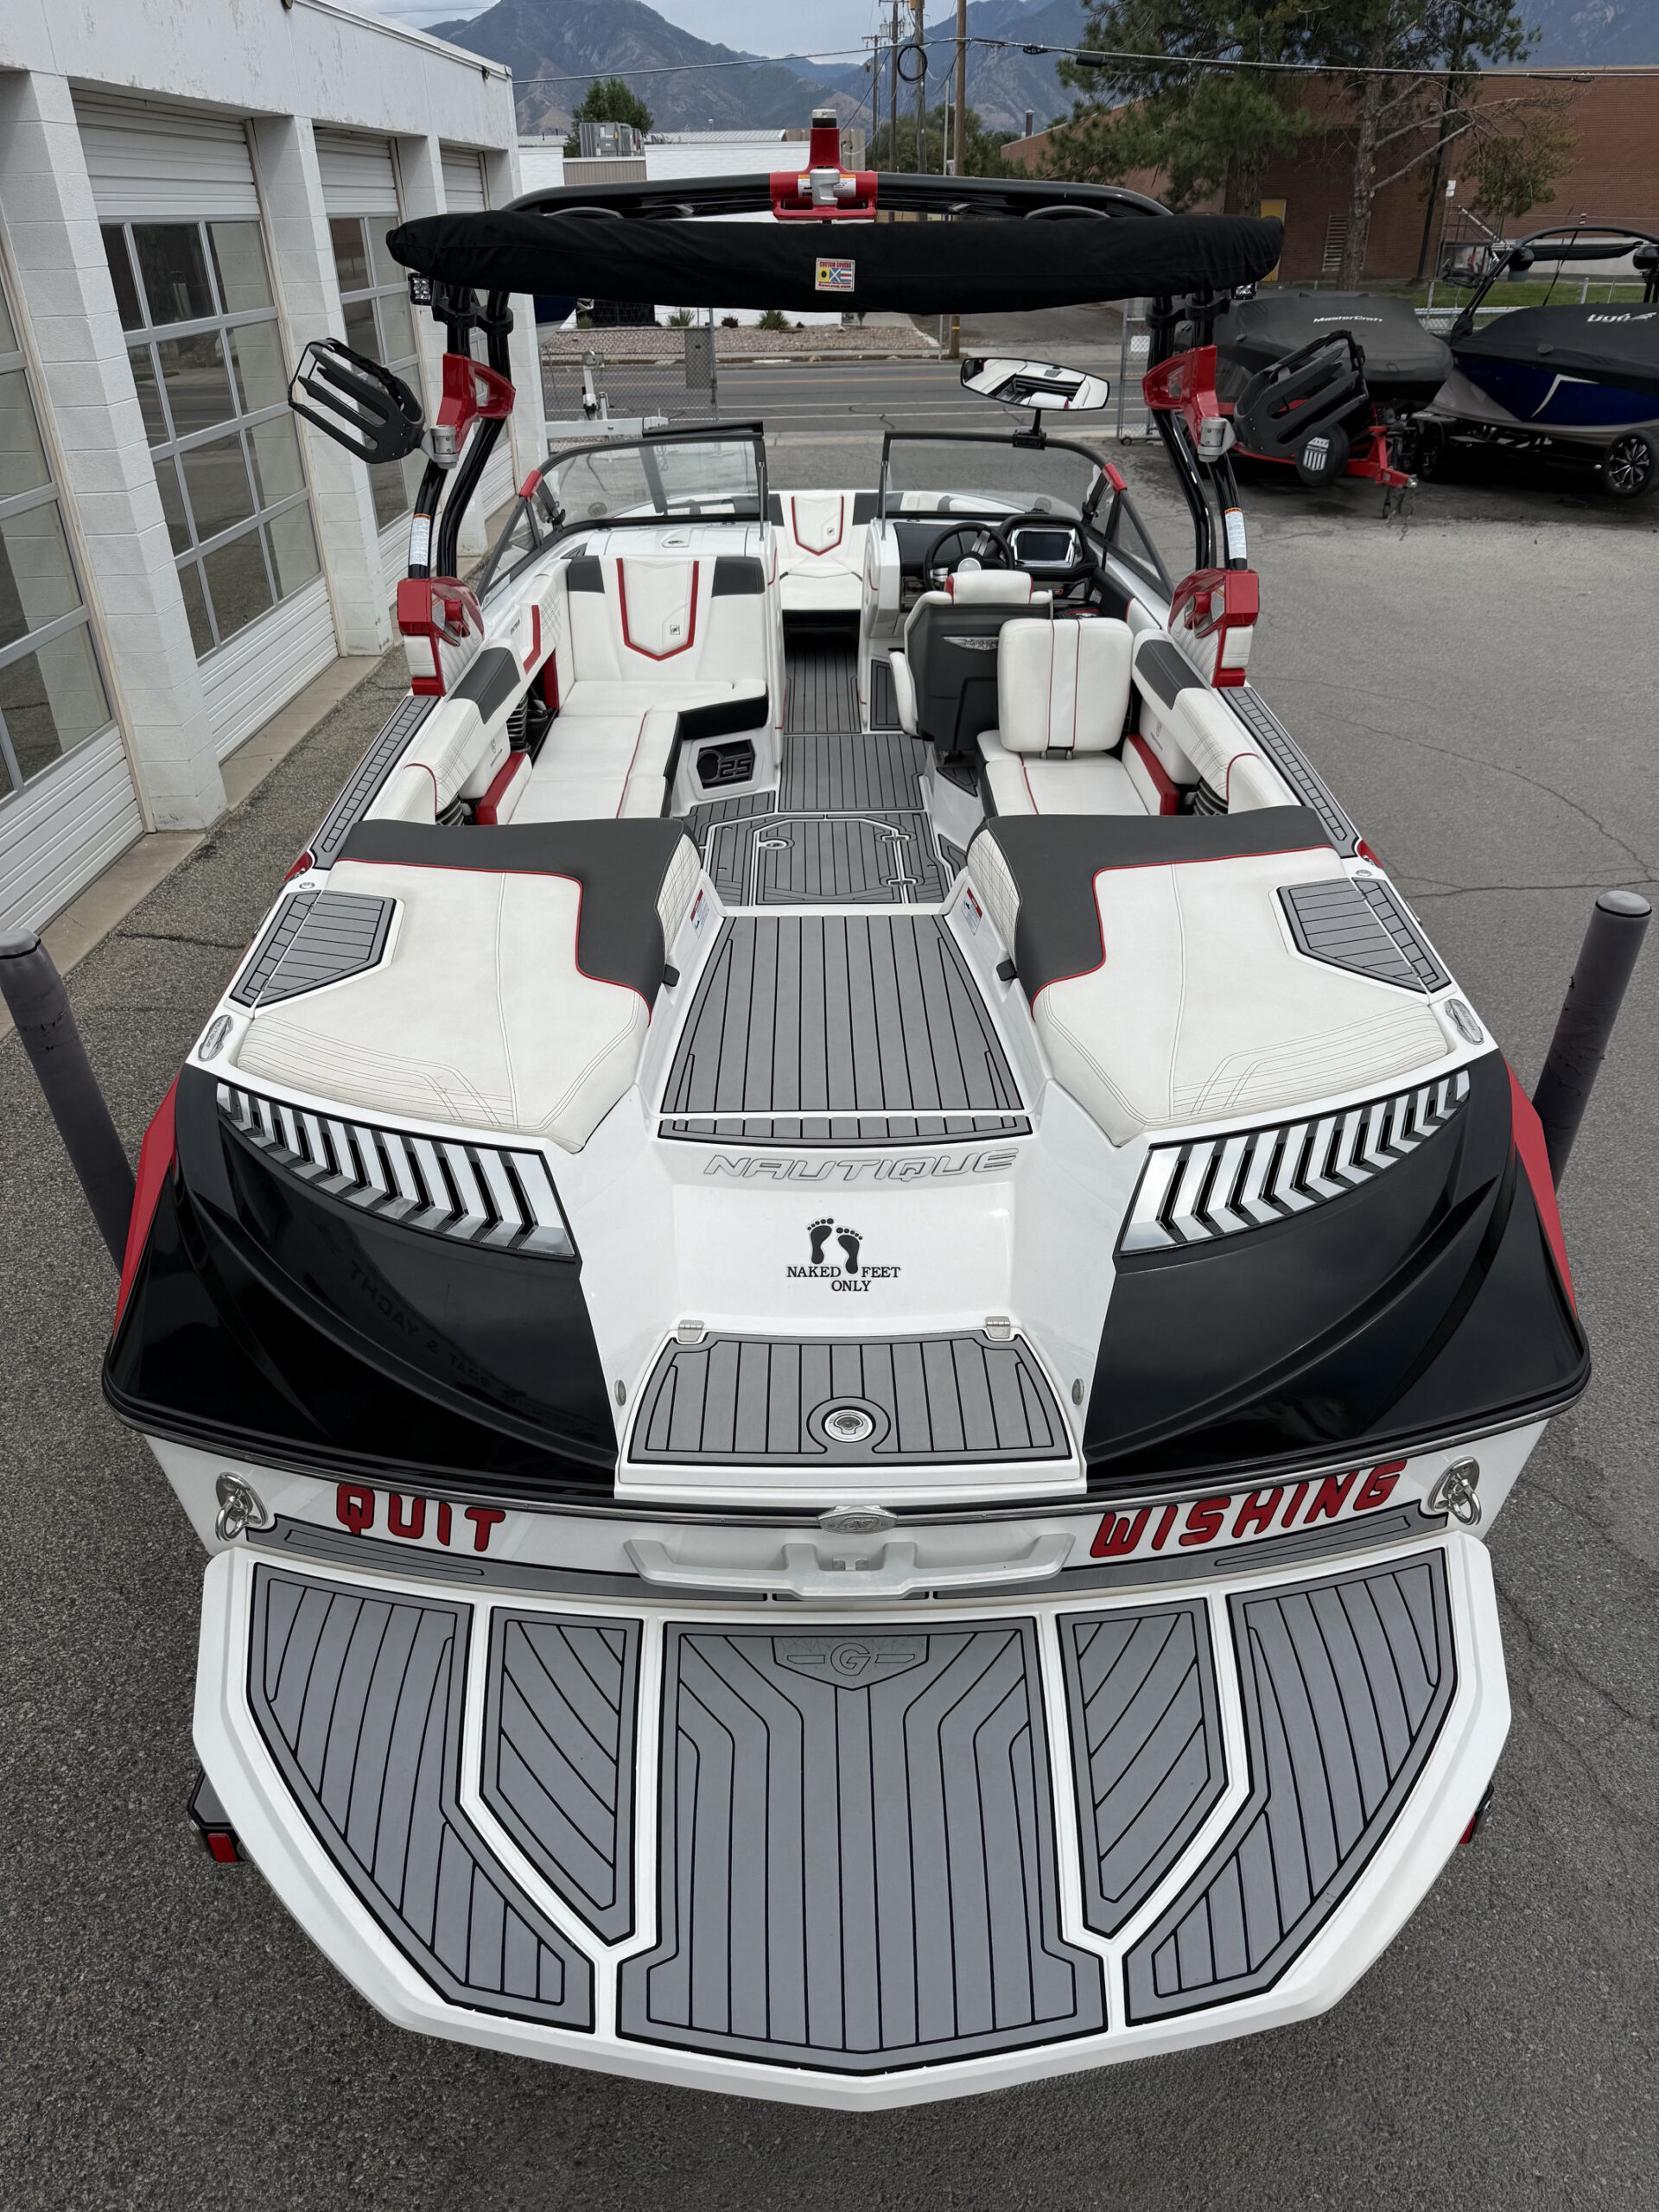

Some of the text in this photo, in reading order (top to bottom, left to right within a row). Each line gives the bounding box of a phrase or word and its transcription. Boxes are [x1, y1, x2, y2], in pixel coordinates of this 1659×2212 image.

[1313, 315, 1383, 323] MasterCraft
[703, 1147, 1020, 1182] NAUTIQUE
[786, 1266, 901, 1279] NAKED FEET
[830, 1280, 872, 1292] ONLY
[335, 1483, 506, 1552] QUIT
[1089, 1459, 1408, 1559] WISHING
[830, 1642, 872, 1676] G
